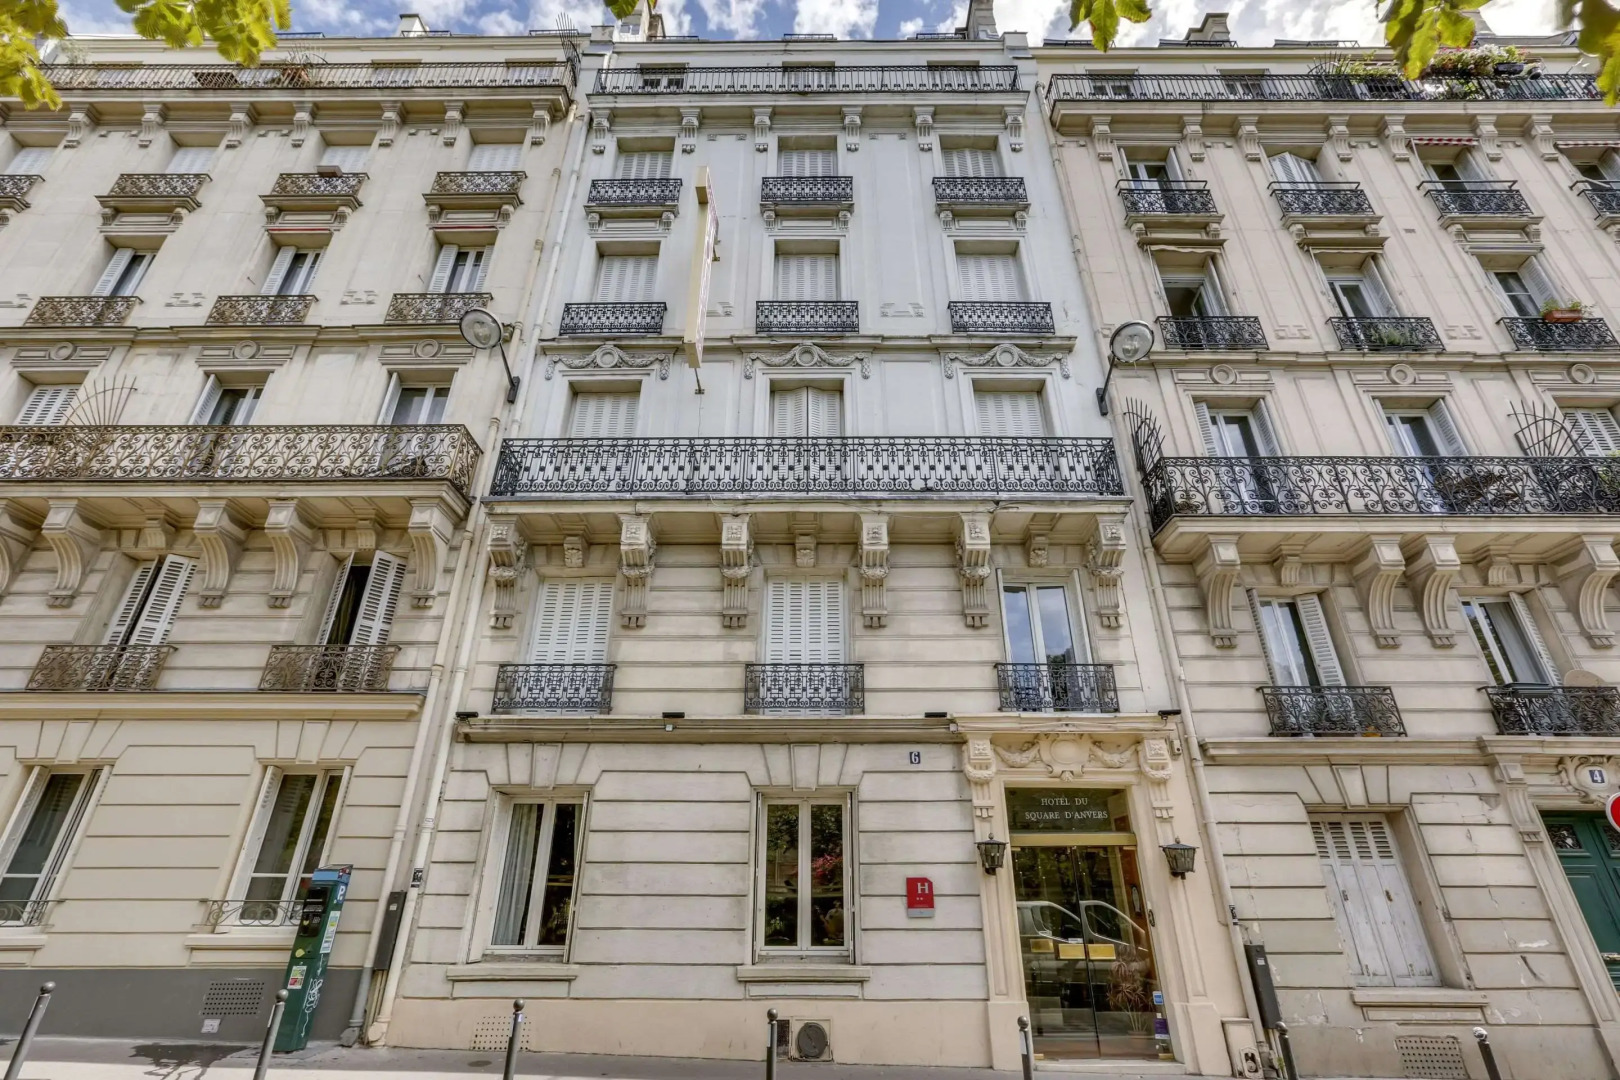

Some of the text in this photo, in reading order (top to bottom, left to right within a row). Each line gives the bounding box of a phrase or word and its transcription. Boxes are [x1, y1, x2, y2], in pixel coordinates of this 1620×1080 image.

[911, 751, 919, 764] 6
[1593, 770, 1602, 783] 4
[1041, 798, 1088, 806] HOTEL DU
[1025, 810, 1108, 821] SQUARE D'ANVERS
[337, 885, 346, 900] P
[917, 882, 929, 894] H
